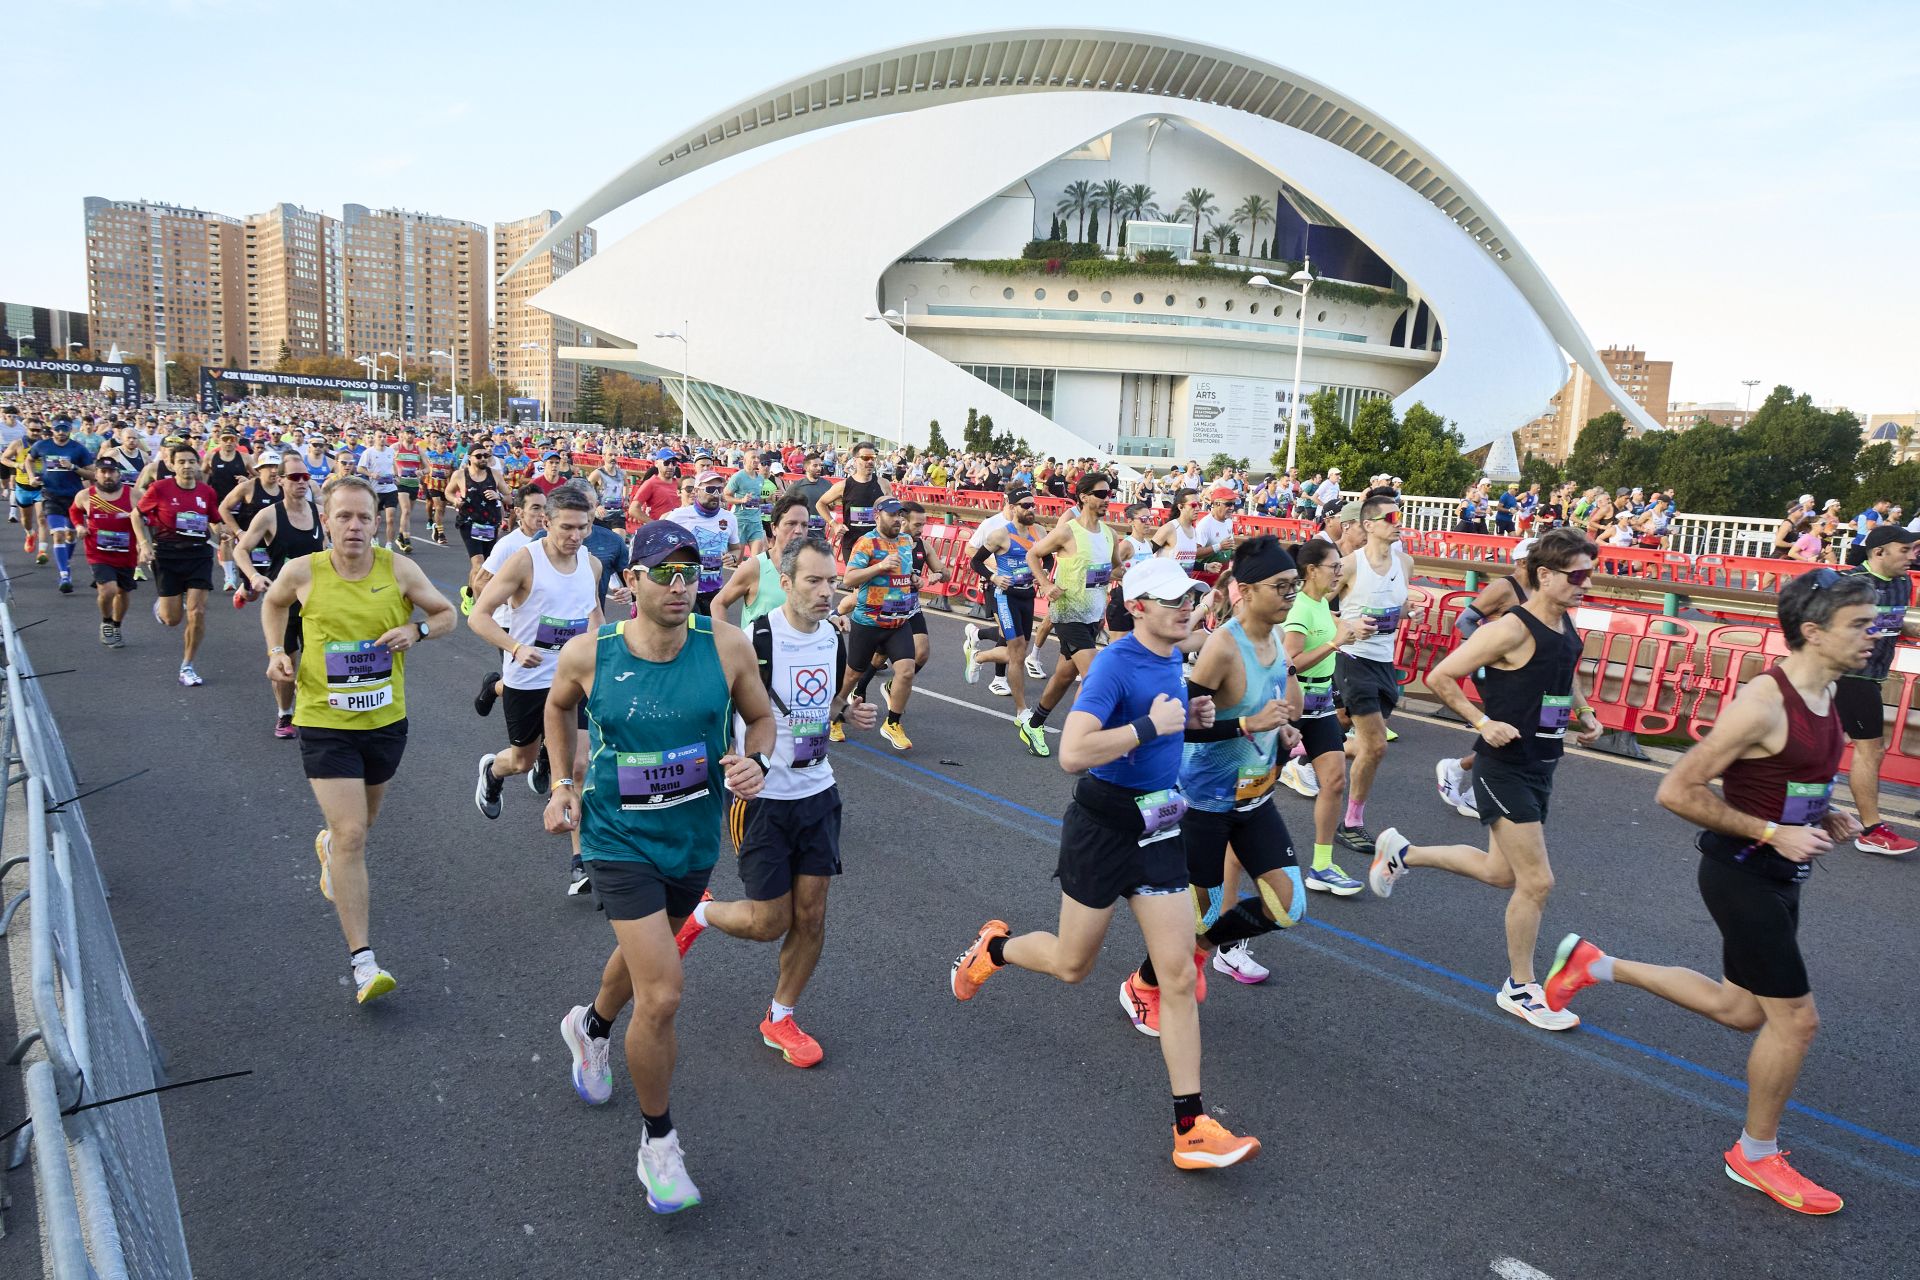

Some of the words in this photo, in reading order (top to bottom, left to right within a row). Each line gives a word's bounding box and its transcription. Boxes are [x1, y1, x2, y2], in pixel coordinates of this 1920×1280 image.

[26, 361, 80, 371] ALFONSO
[222, 371, 239, 379] 42K
[240, 372, 276, 383] VALENCIA
[278, 376, 323, 386] TRINIDAD
[323, 379, 368, 389] ALFONSO
[1197, 382, 1210, 390] LES
[1196, 391, 1216, 399] ARTS
[344, 652, 376, 664] 10870
[348, 666, 373, 674] Philip
[347, 691, 385, 709] PHILIP
[677, 747, 698, 757] ZURICH
[643, 764, 685, 781] 11719
[650, 780, 681, 793] Manu
